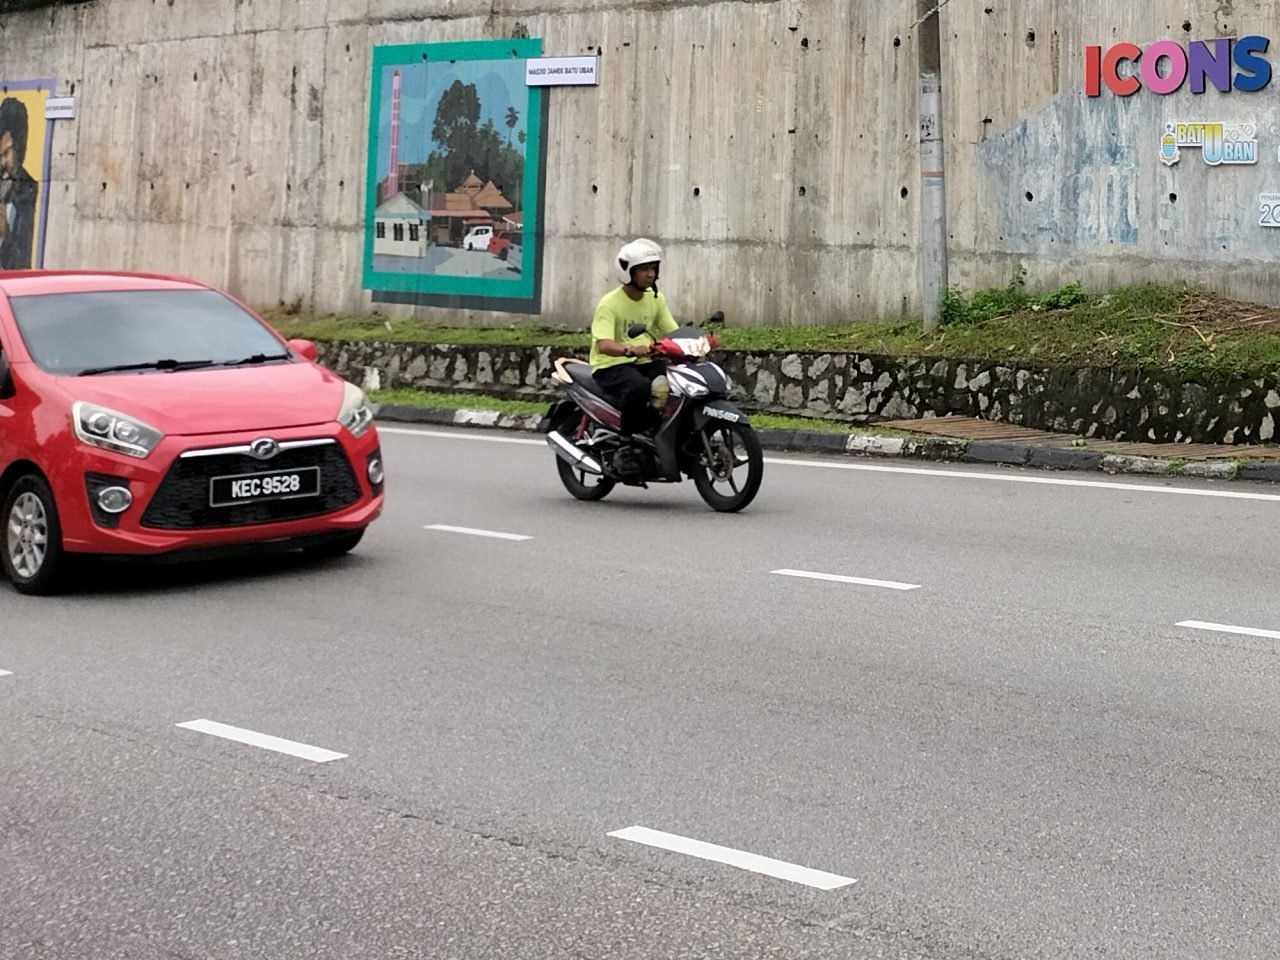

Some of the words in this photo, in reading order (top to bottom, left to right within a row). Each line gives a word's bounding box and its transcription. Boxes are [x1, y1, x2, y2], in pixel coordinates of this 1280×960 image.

[1085, 35, 1272, 97] ICONS
[231, 478, 261, 498] KEC
[262, 474, 300, 494] 9528
